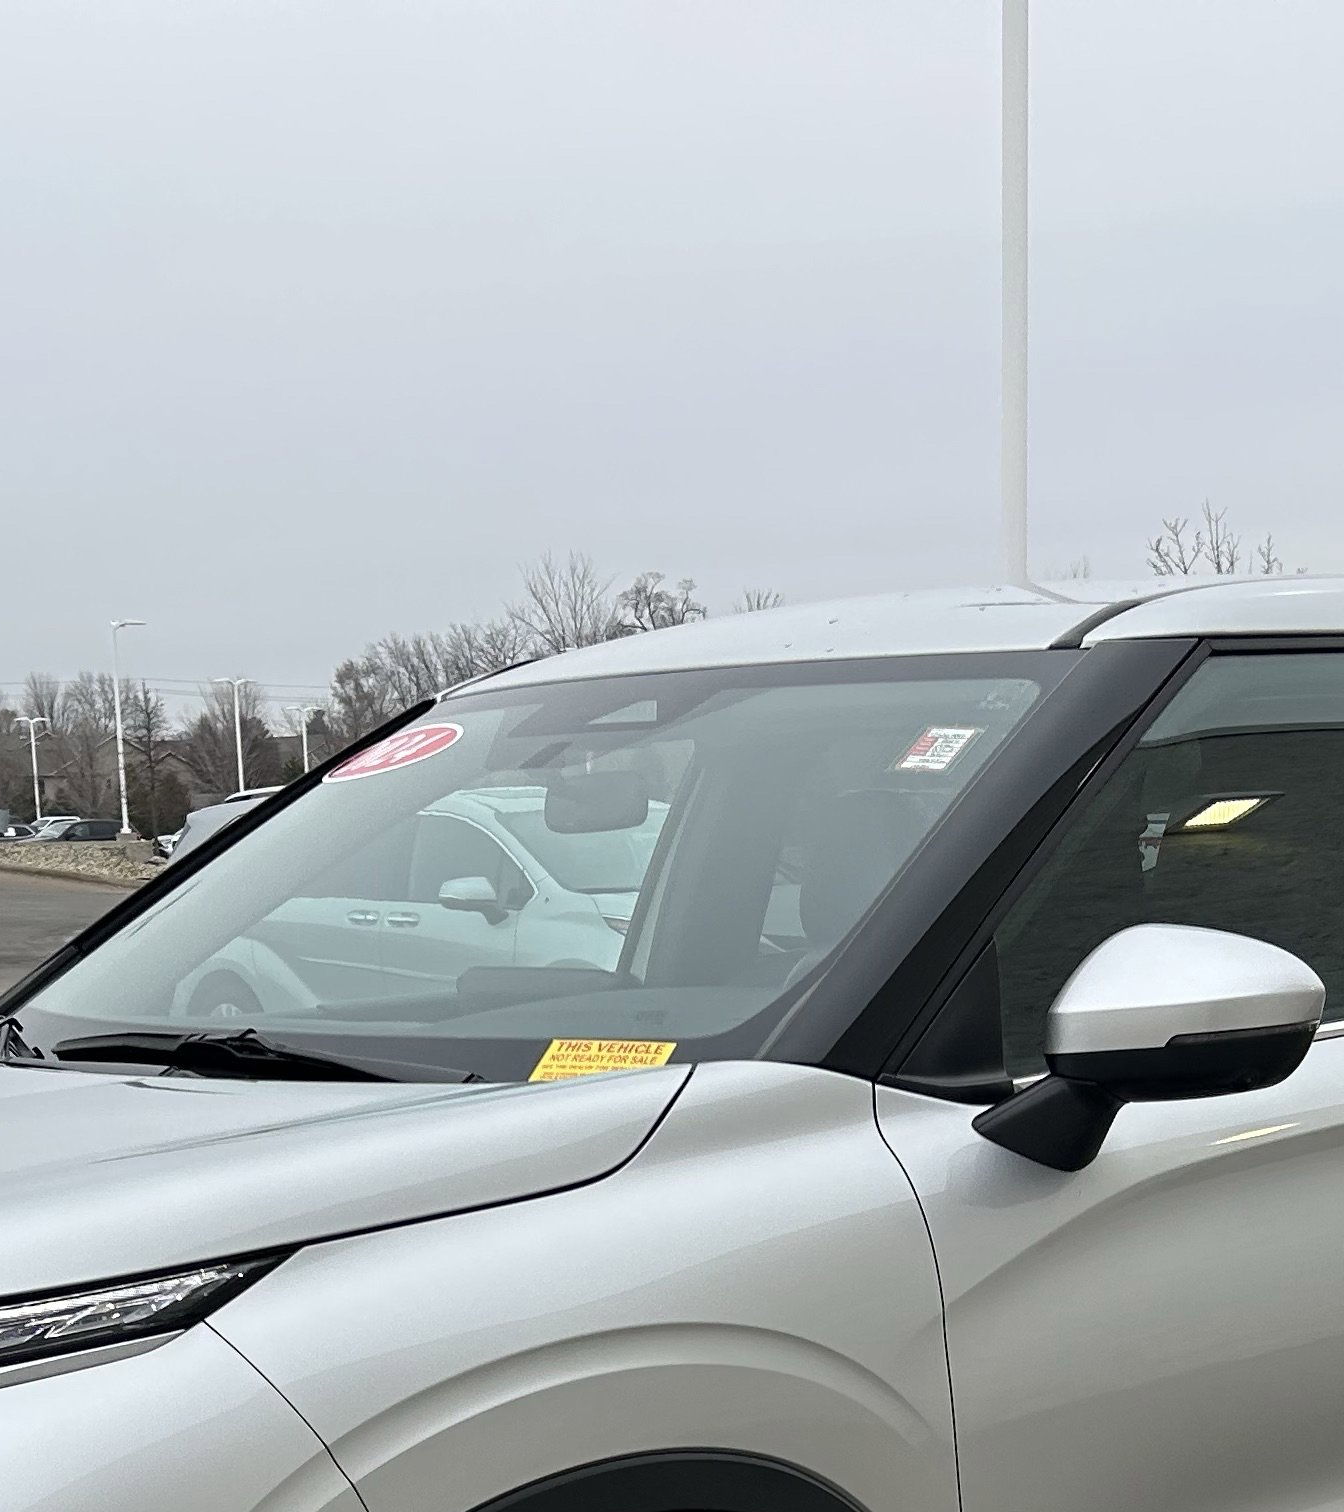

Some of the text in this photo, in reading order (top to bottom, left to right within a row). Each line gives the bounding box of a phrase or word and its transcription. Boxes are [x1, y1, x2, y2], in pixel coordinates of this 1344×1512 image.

[556, 1040, 665, 1056] THIS VEHICLE
[549, 1053, 659, 1066] NOT READY FOR SALE
